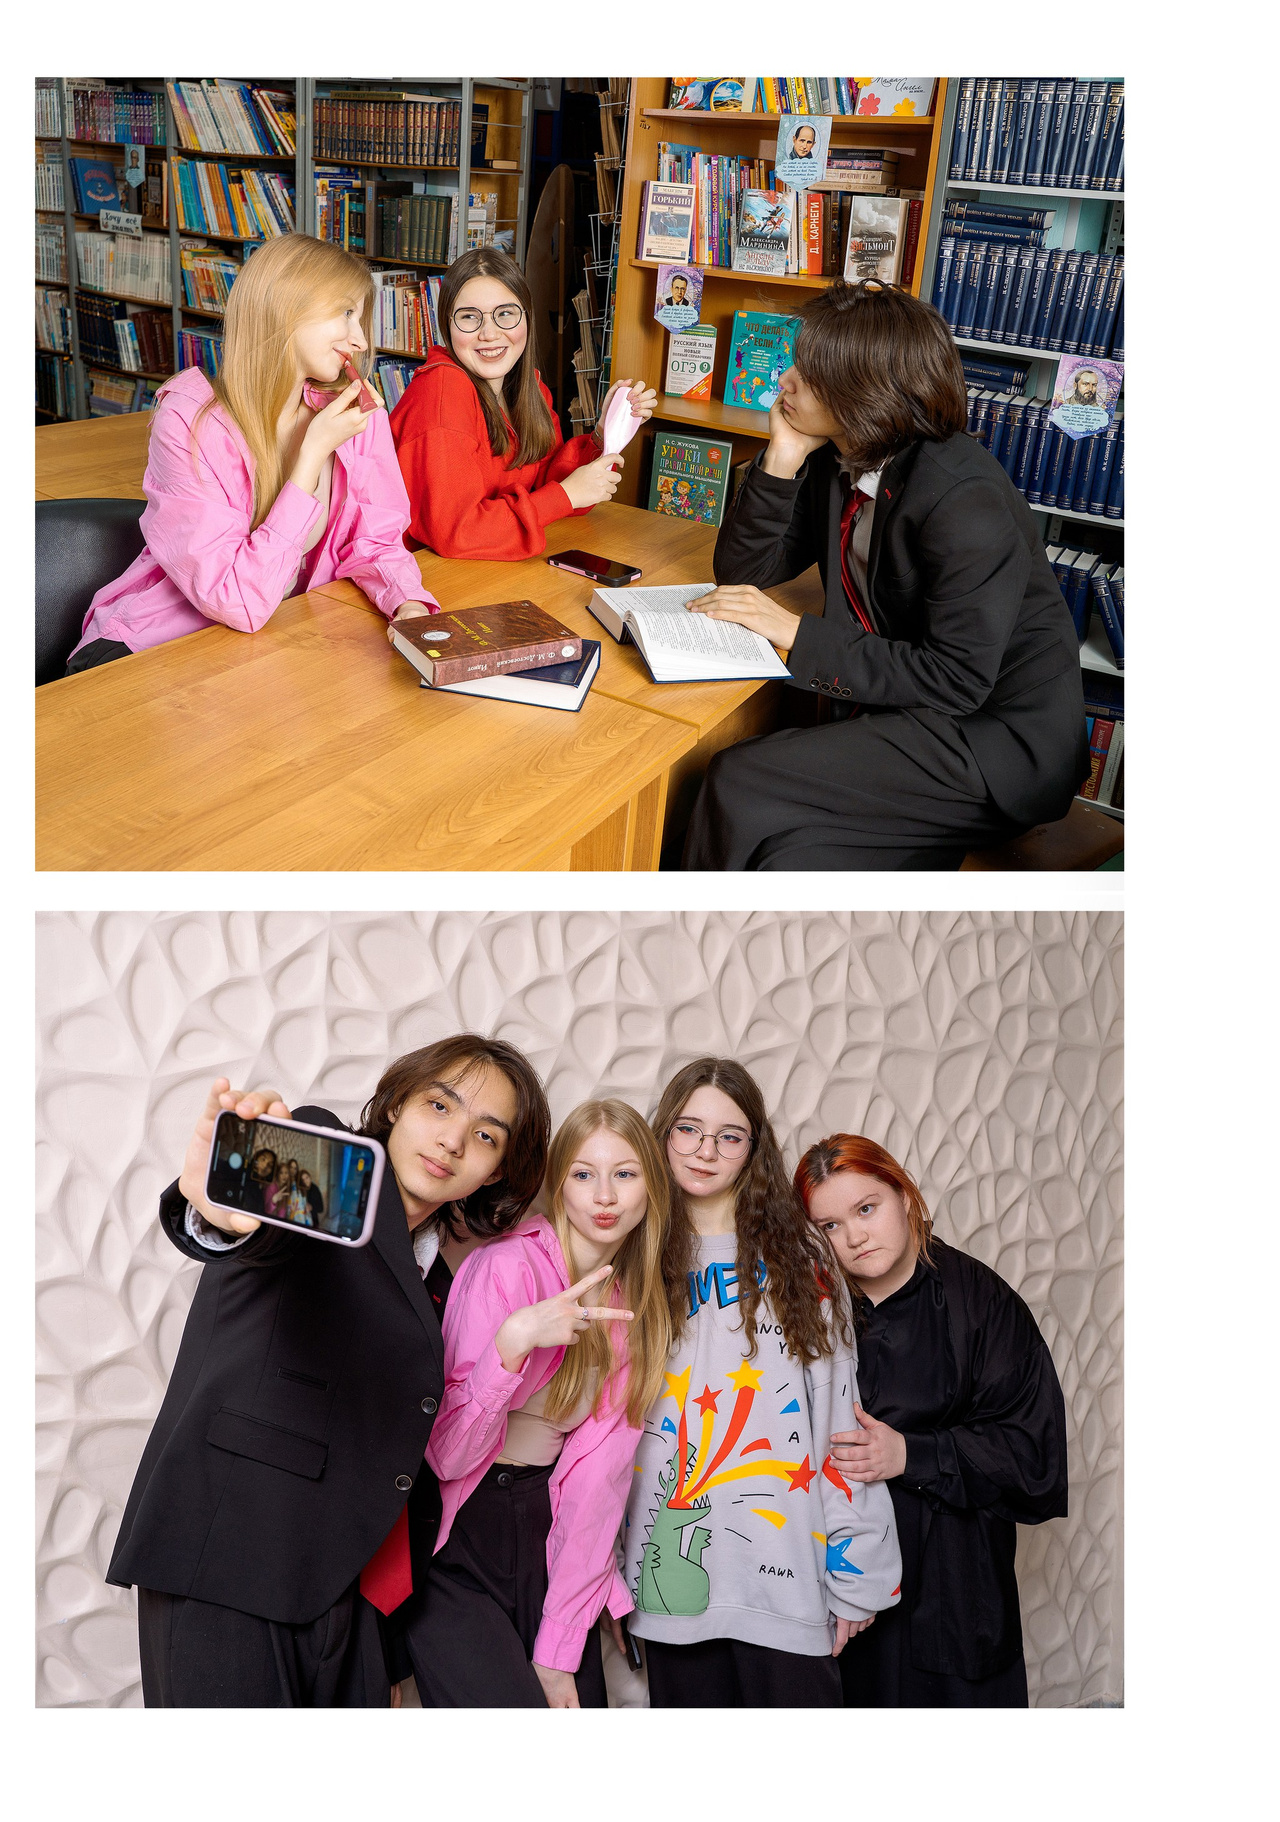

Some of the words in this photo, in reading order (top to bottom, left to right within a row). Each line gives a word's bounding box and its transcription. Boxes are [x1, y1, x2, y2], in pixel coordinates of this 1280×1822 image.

[653, 194, 693, 207] ГОРЬКИЙ
[740, 237, 786, 252] МАРИНИНА
[750, 237, 779, 245] АЛЕКСАНДРА
[745, 322, 759, 333] ЧТО
[671, 361, 697, 374] ОГЭ
[679, 442, 700, 450] ЖУКОВА
[661, 444, 701, 464] УРОКИ
[659, 458, 704, 476] ПРАВИЛЬНОЙ
[705, 466, 723, 479] РЕЧИ
[496, 654, 535, 667] Достоевский
[788, 1431, 800, 1443] A
[758, 1563, 795, 1579] RAWR
